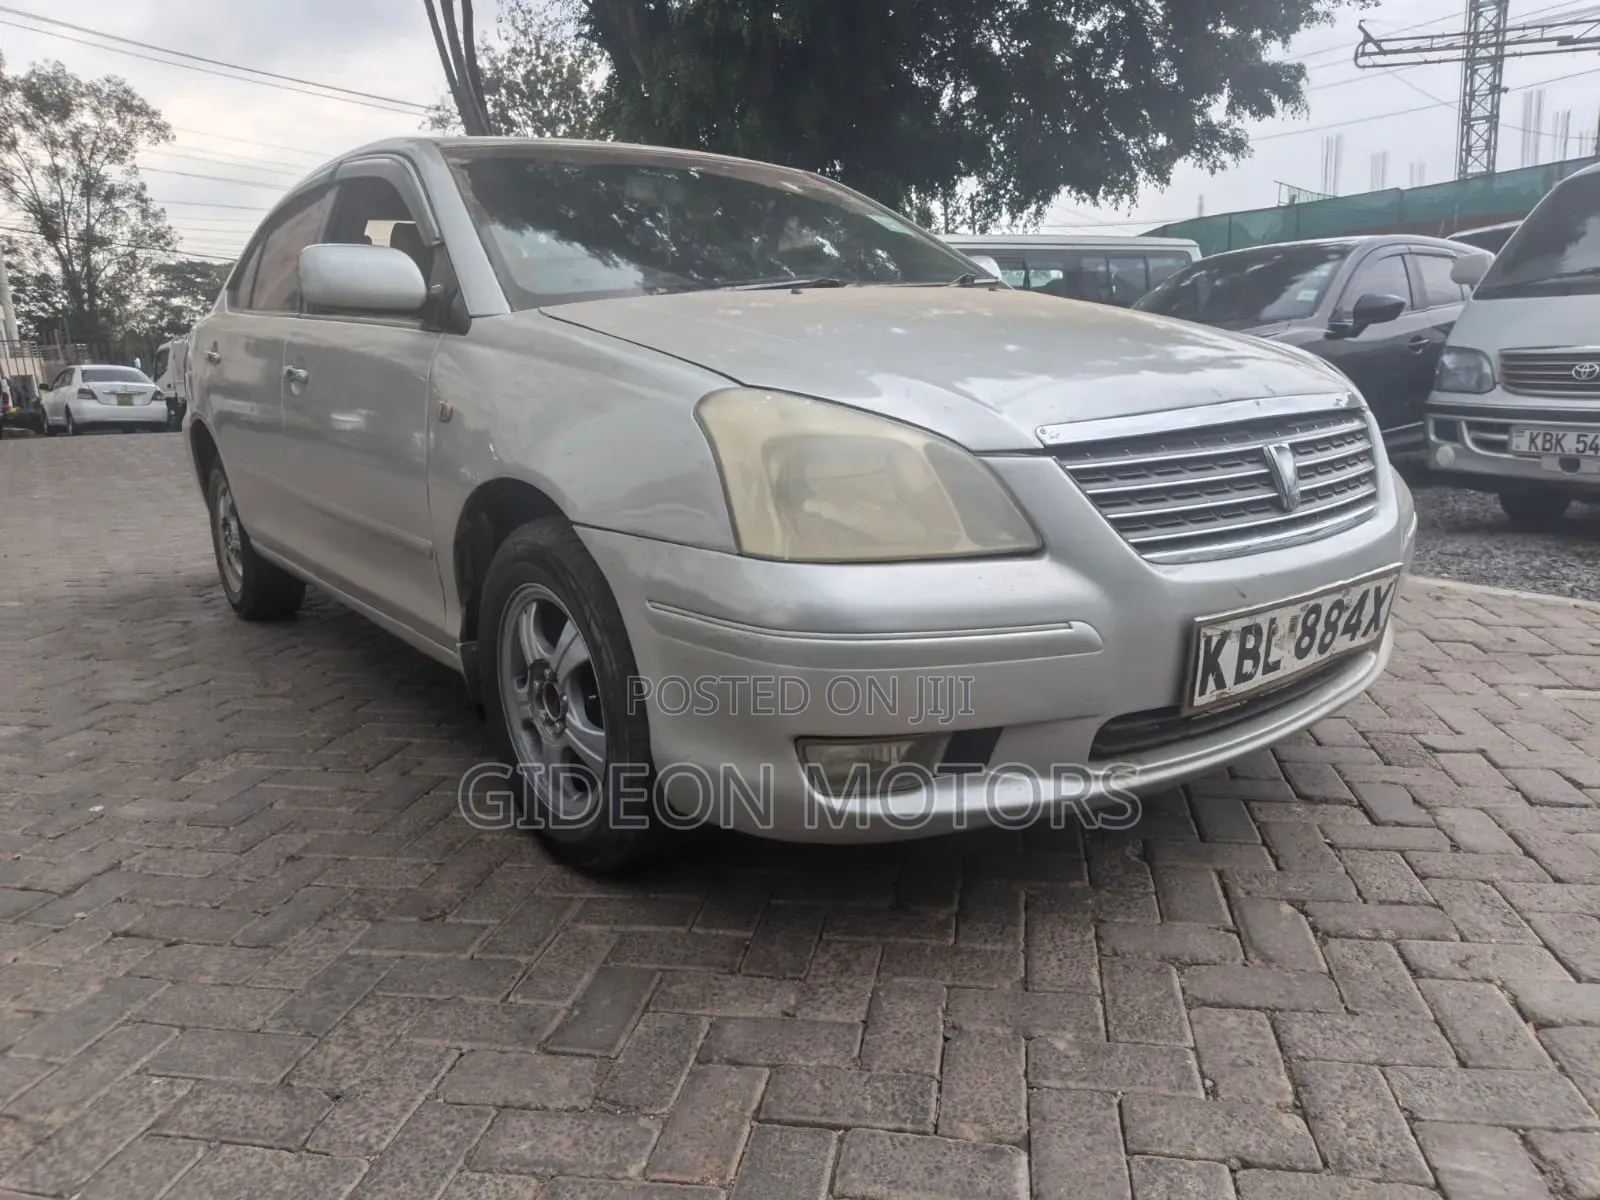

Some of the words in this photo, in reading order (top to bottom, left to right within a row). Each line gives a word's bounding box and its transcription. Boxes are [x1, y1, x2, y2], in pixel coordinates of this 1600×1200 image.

[1528, 431, 1567, 453] KBK
[1198, 617, 1281, 697] KBL
[1294, 580, 1395, 661] 884X
